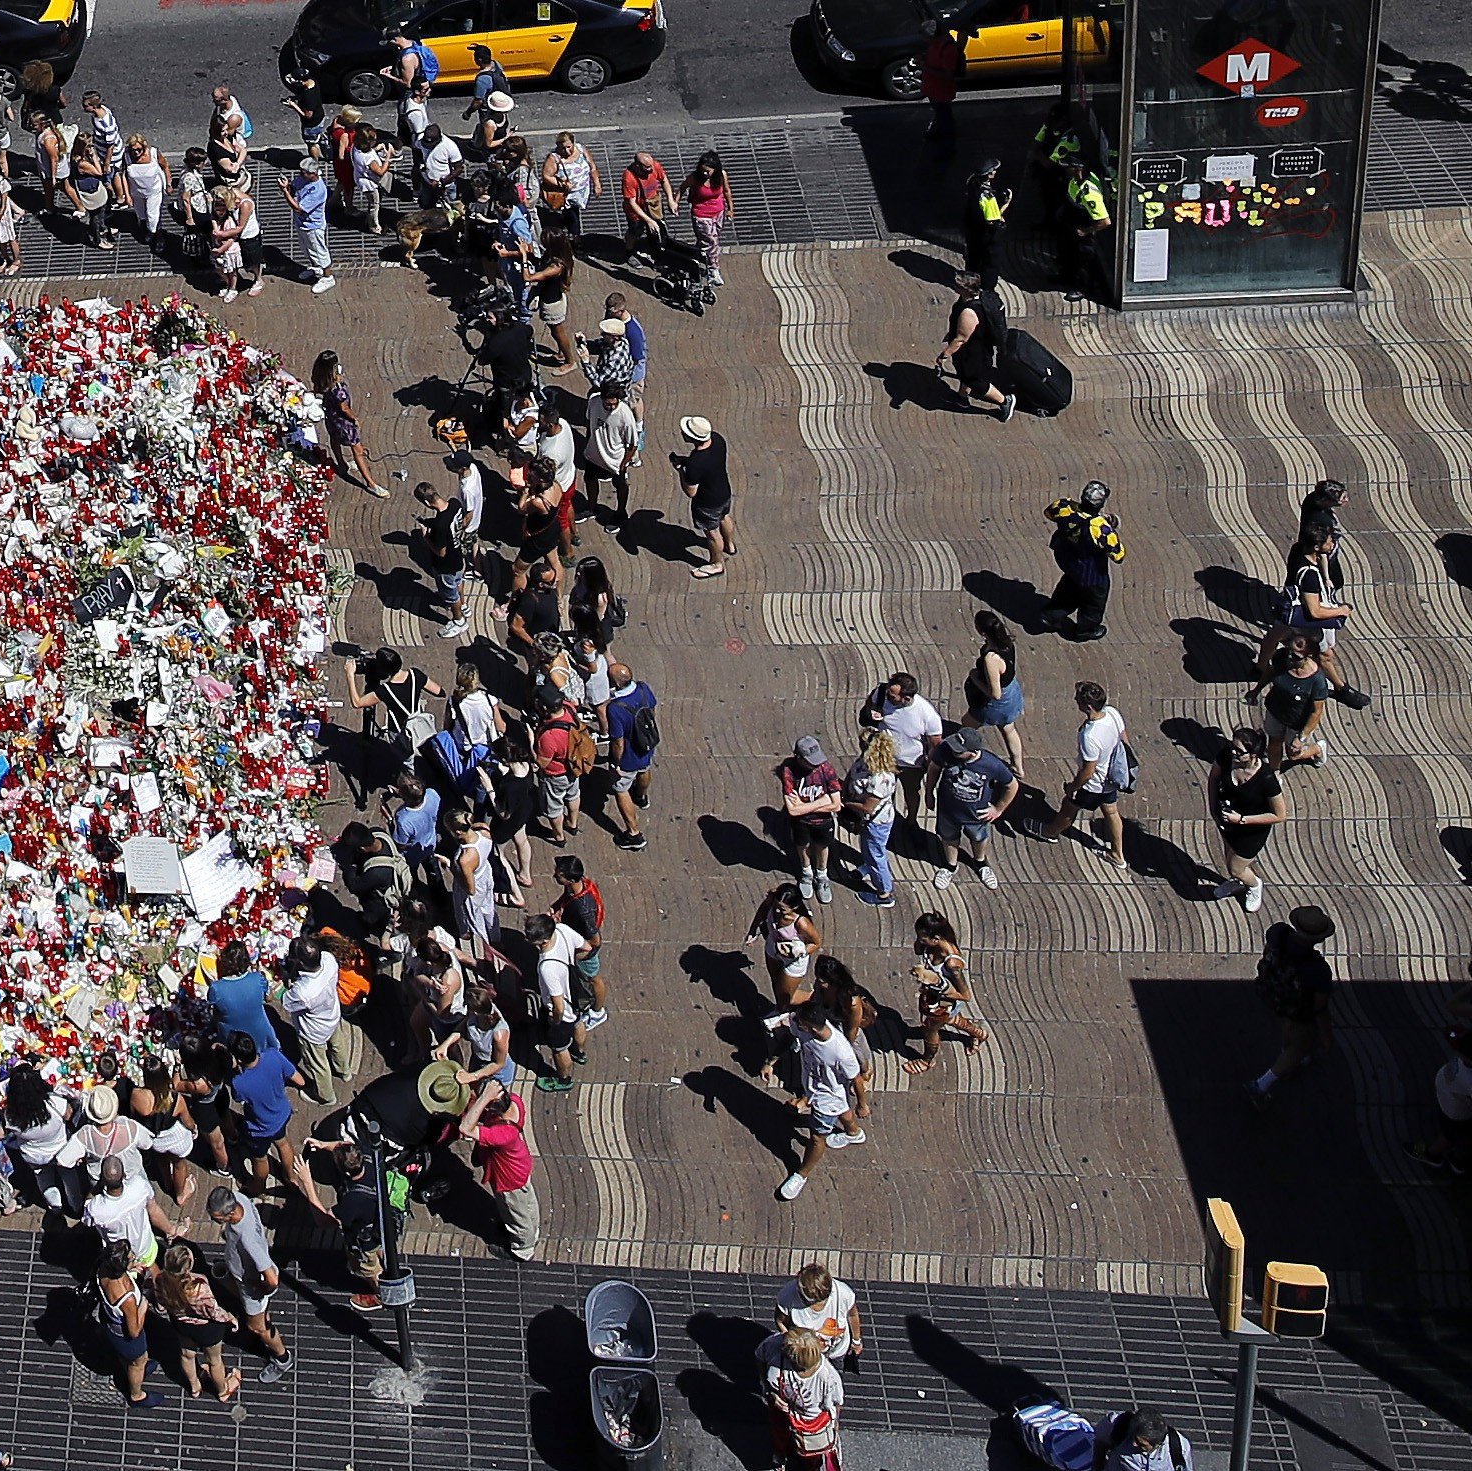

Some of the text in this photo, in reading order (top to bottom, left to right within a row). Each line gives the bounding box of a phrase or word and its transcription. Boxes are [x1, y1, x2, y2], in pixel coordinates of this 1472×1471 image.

[1226, 52, 1271, 83] M
[1264, 107, 1300, 118] TMB
[81, 578, 115, 614] PRAY
